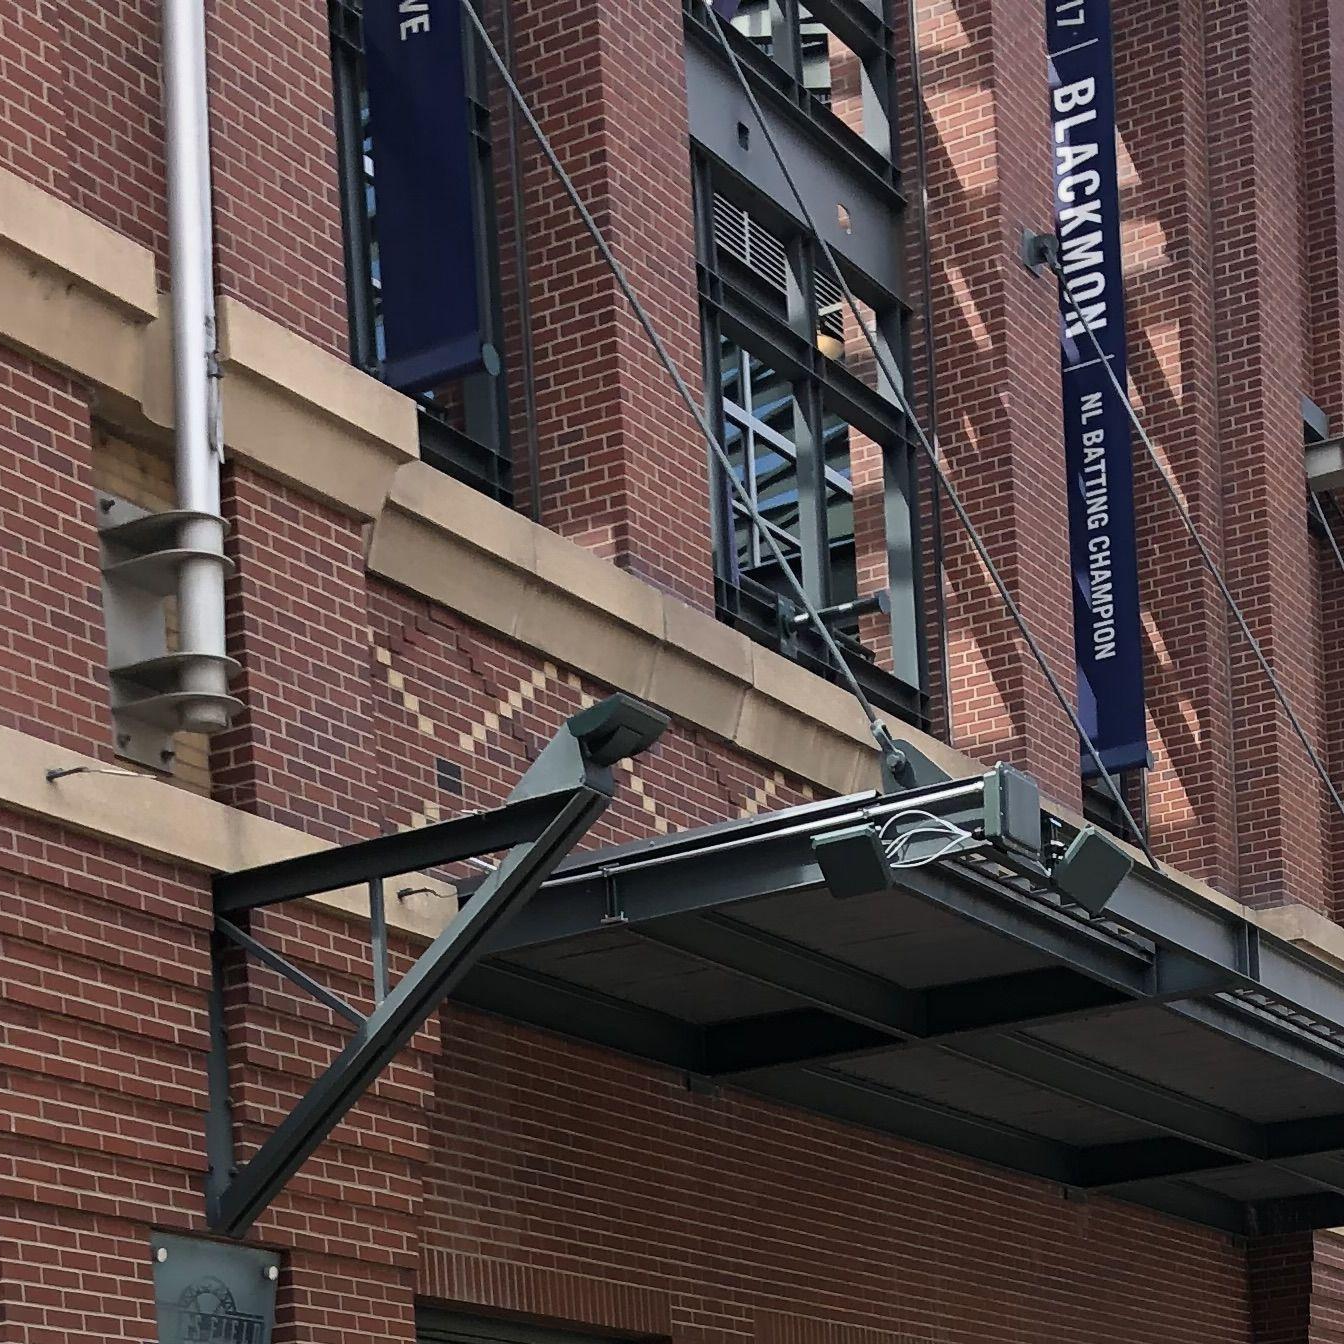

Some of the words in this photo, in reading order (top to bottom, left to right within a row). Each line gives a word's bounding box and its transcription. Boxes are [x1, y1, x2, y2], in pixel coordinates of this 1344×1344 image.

[1053, 76, 1107, 339] BLACKMON
[1080, 391, 1103, 425] NL
[1082, 428, 1109, 531] BATTING
[1088, 535, 1116, 661] CHAMPION
